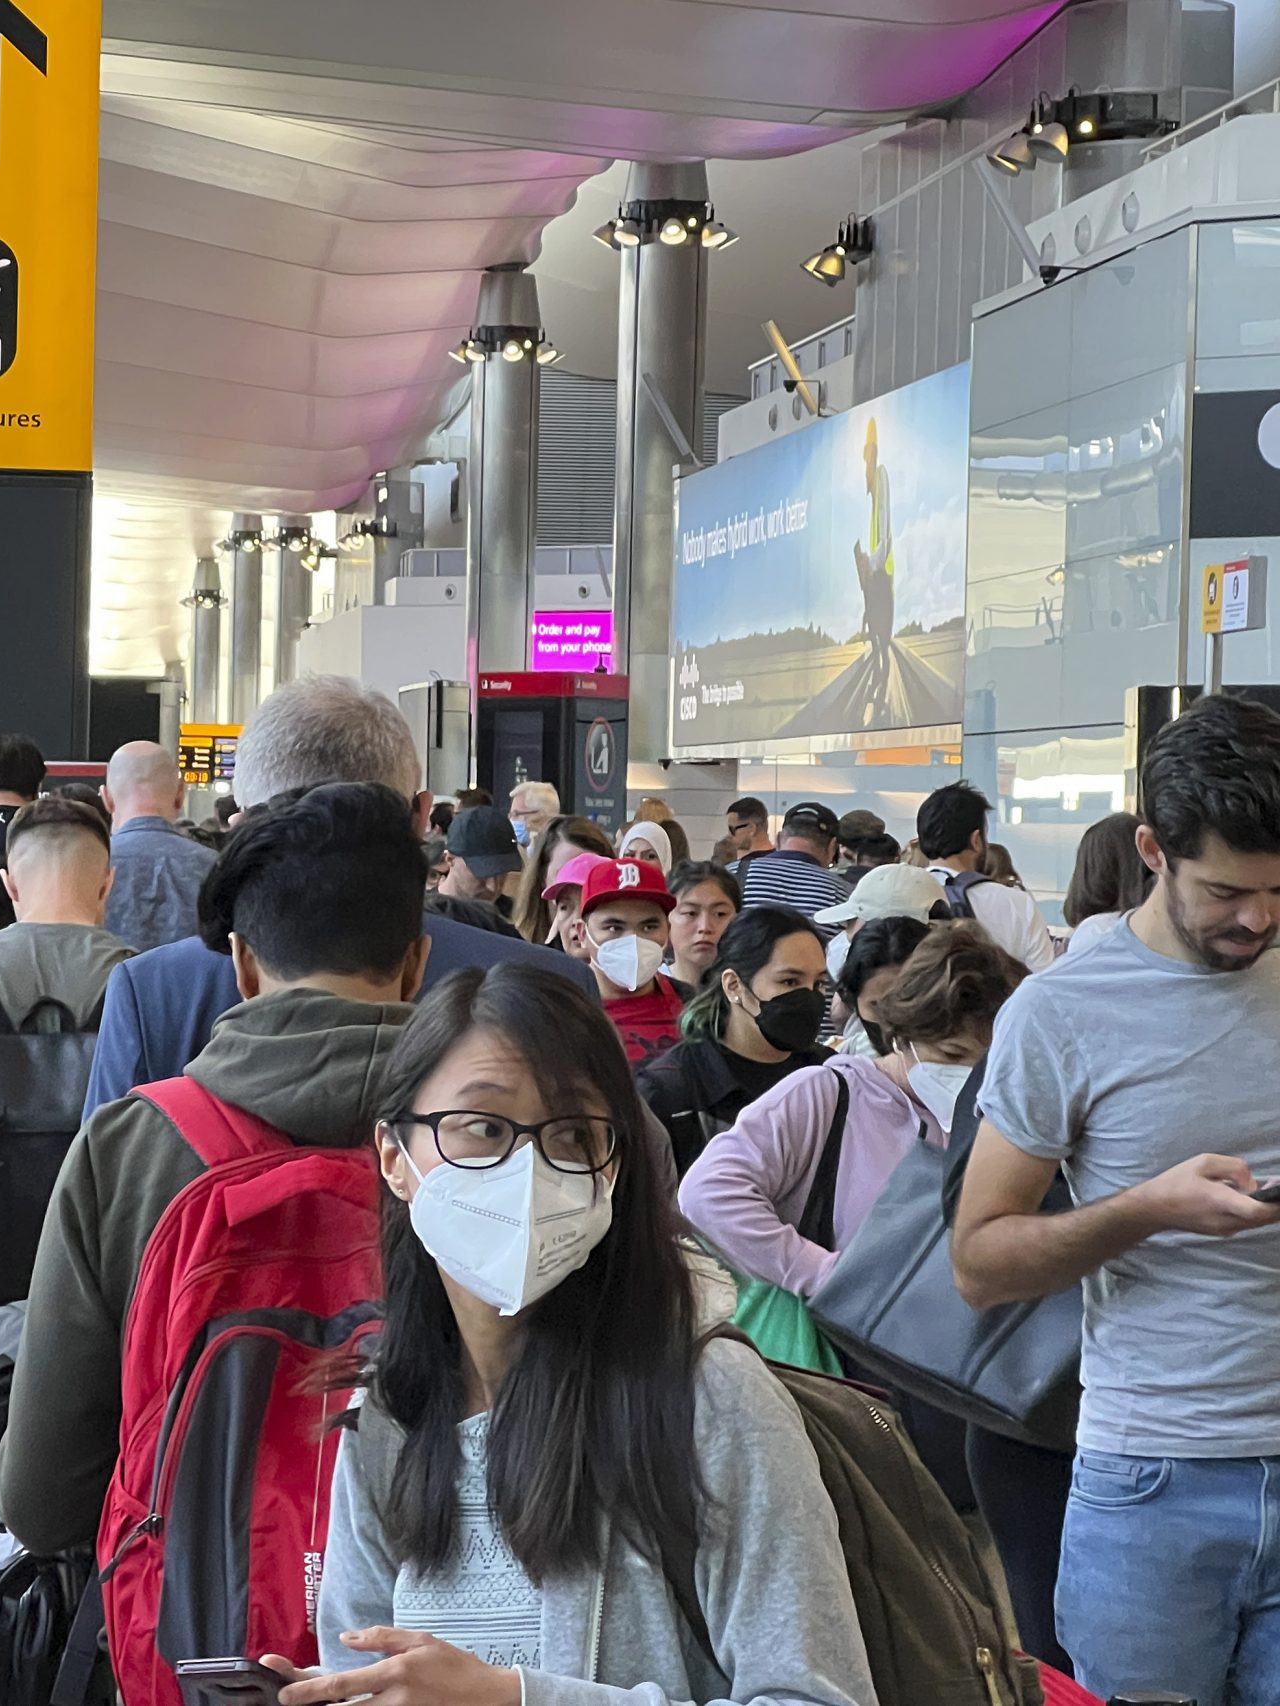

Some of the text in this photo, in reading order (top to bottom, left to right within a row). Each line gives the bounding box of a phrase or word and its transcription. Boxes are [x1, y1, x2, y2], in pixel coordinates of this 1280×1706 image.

[682, 526, 707, 568] Nobody
[706, 521, 727, 557] makes
[727, 511, 748, 559] hybrid
[767, 499, 785, 539] work
[538, 623, 563, 636] Order
[565, 622, 583, 636] and
[584, 625, 601, 638] pay
[538, 640, 612, 656] from your phone
